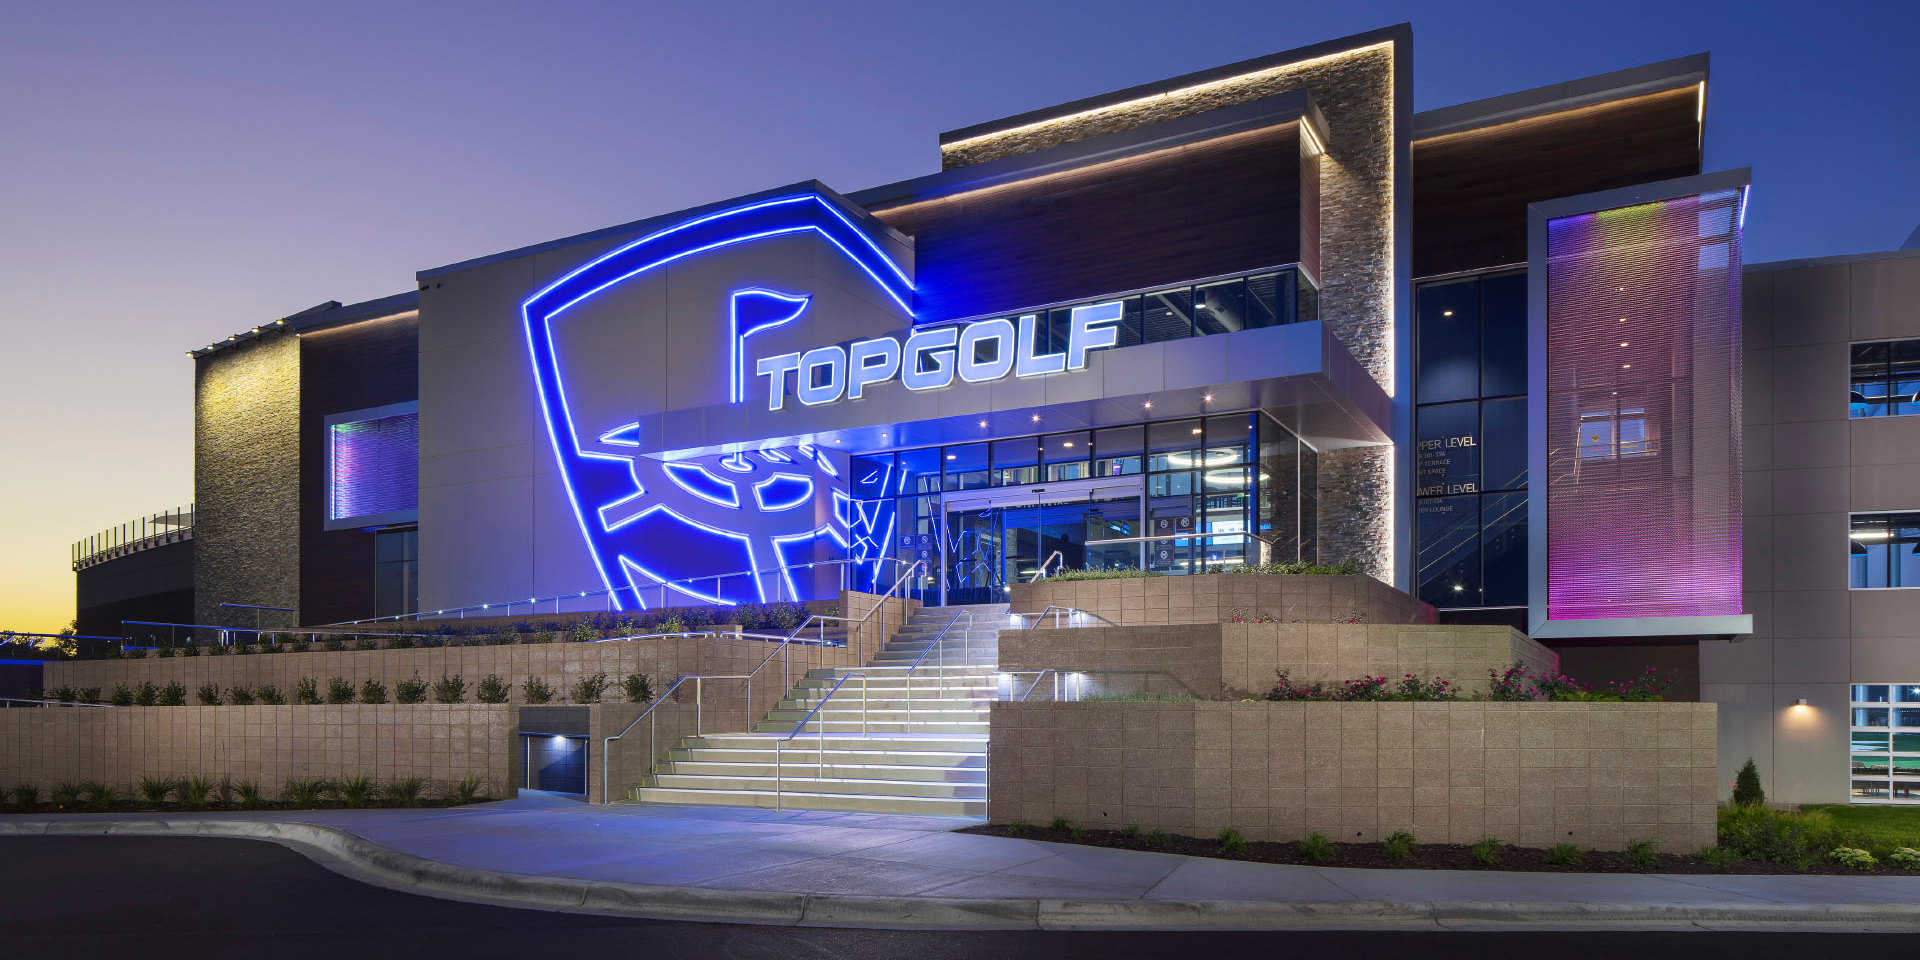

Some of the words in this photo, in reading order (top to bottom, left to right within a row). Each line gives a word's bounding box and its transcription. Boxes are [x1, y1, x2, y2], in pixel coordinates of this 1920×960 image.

[757, 301, 1123, 411] TOPGOLF
[1445, 436, 1476, 448] LEVEL
[1424, 459, 1451, 467] TERRACE
[1447, 483, 1478, 495] LEVEL
